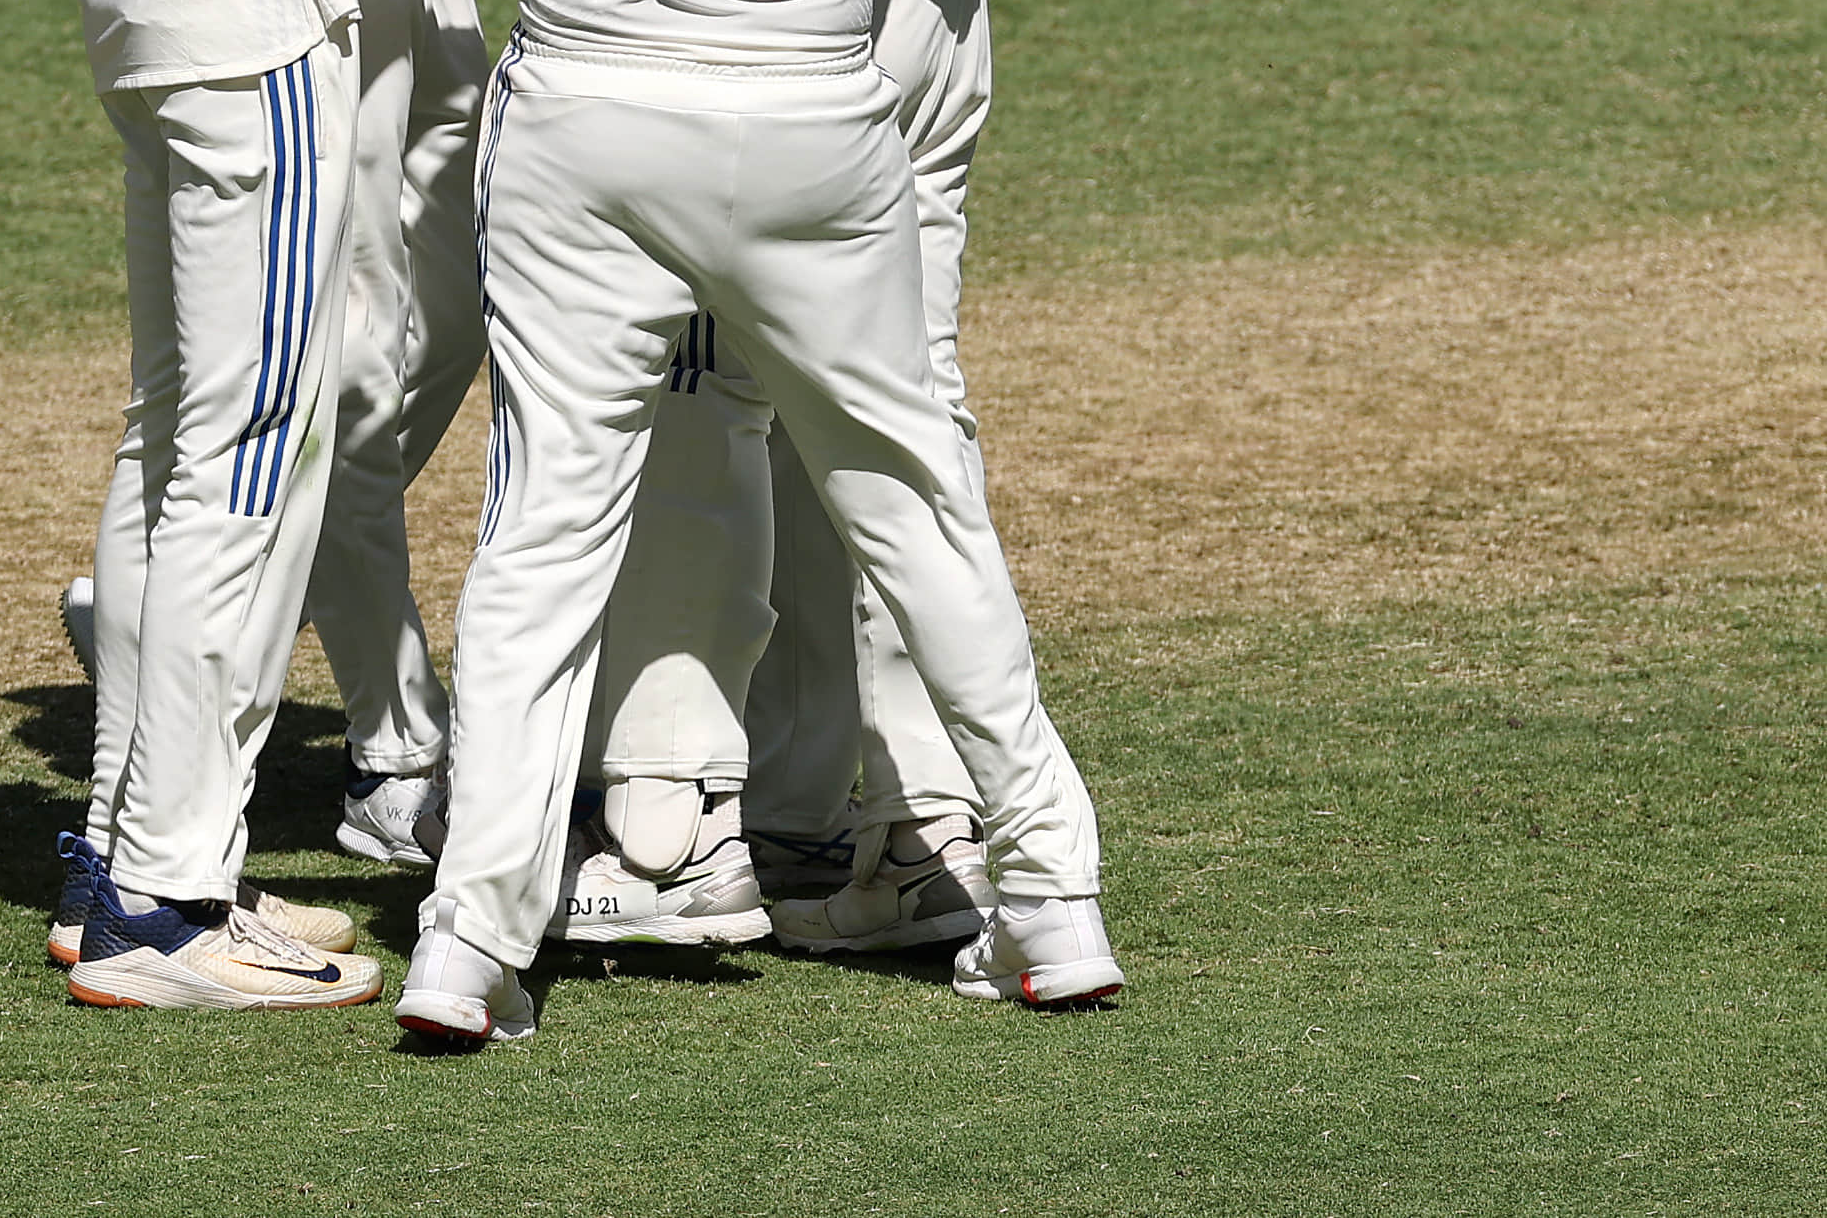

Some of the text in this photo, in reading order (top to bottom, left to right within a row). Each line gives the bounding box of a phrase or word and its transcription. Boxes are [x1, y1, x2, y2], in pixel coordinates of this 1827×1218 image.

[386, 805, 404, 821] VK
[565, 896, 620, 916] DJ 21
